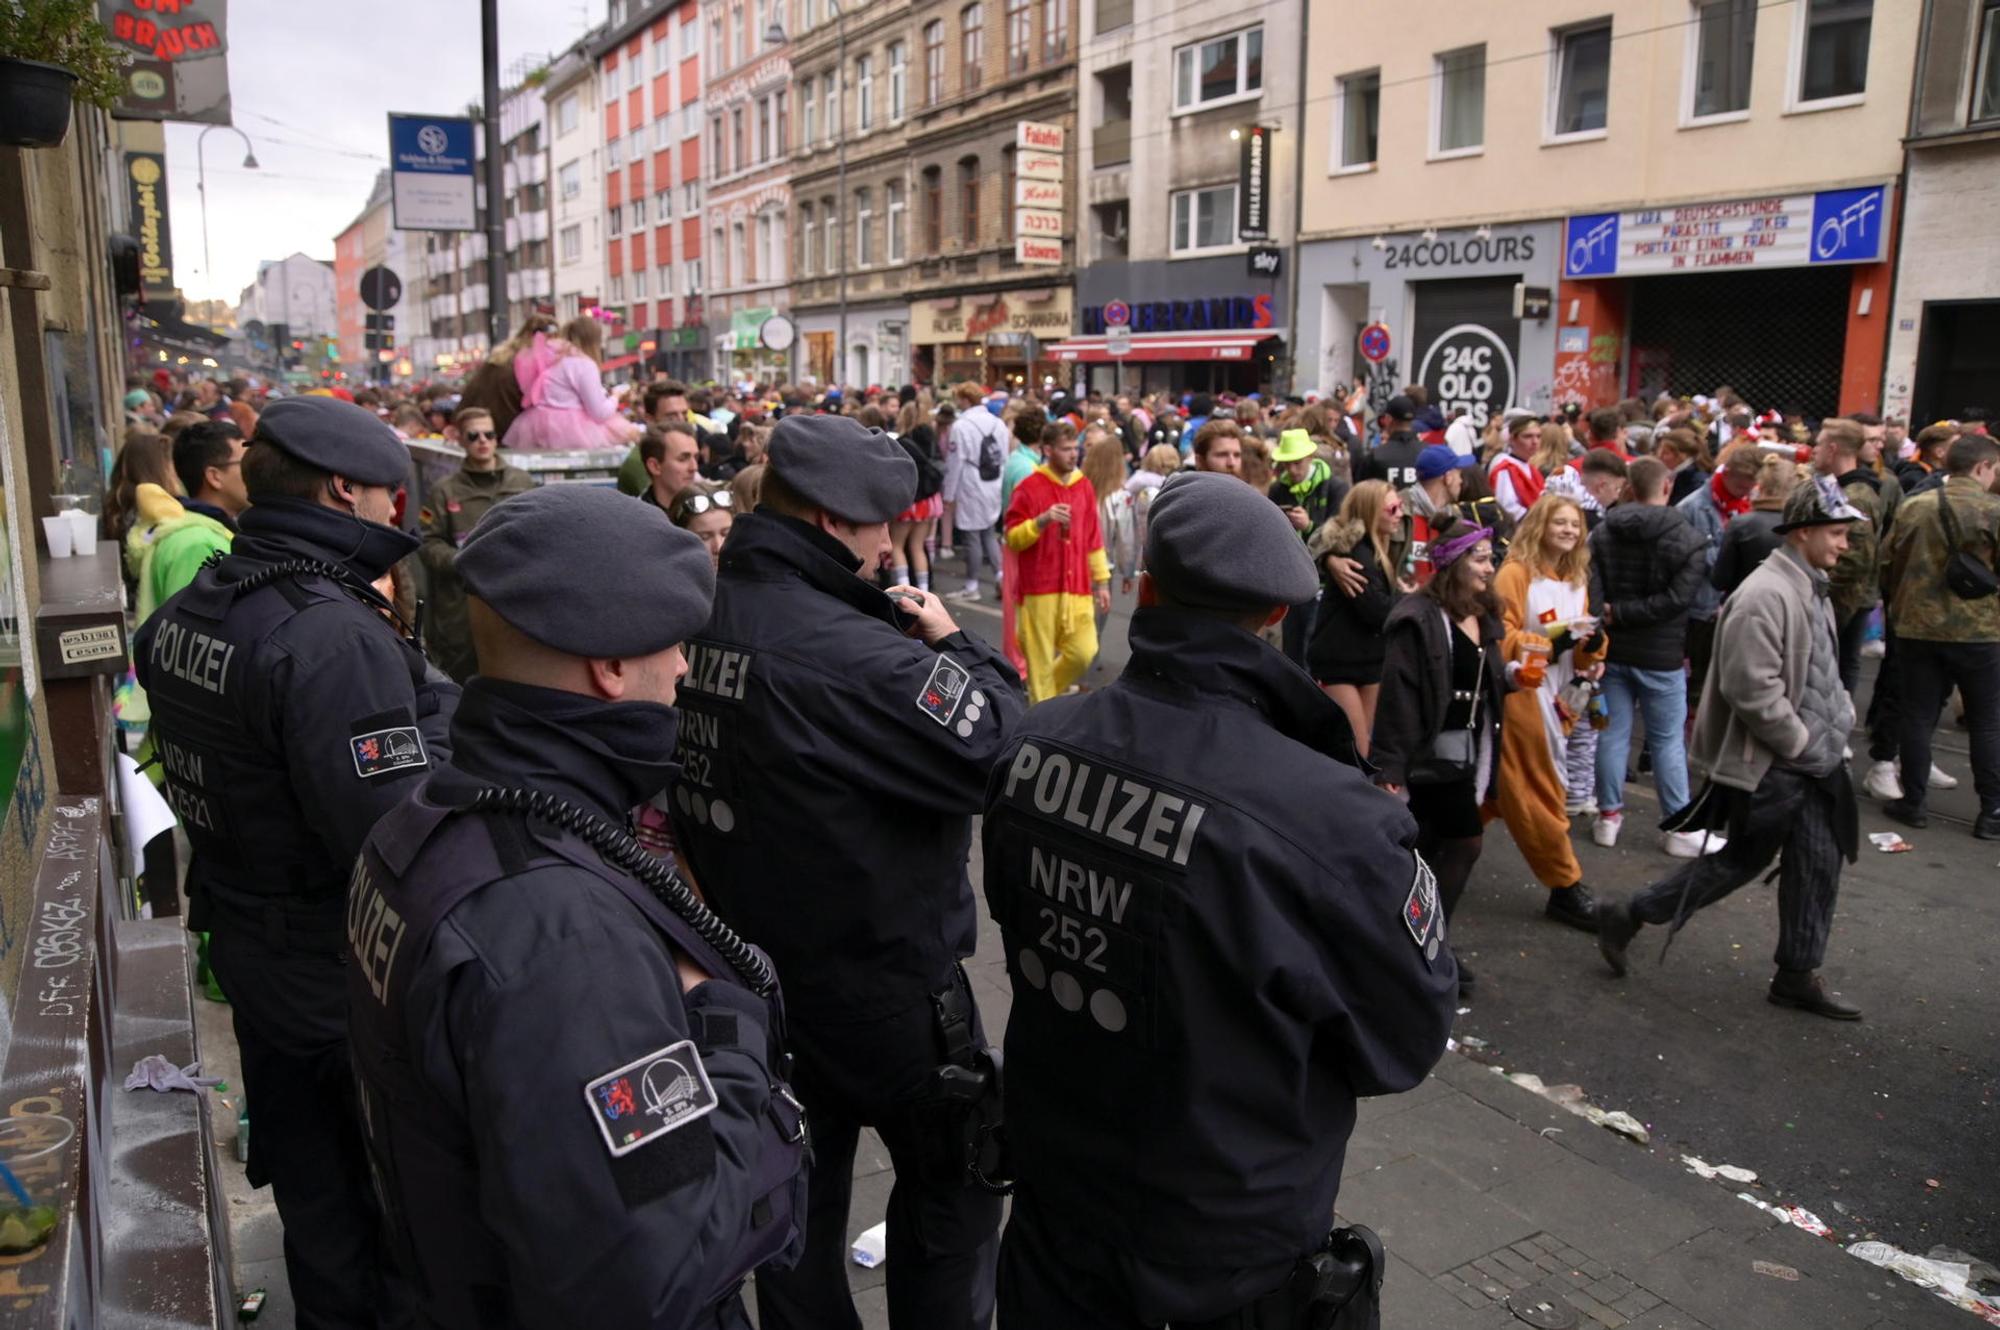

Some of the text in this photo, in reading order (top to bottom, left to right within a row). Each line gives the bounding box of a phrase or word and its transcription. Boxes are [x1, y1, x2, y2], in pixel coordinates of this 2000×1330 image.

[114, 11, 221, 62] BRAUCH
[1025, 125, 1060, 147] Falafel
[1662, 215, 1789, 238] PARASITE JOKER
[1673, 199, 1784, 223] DEUTSCHSTUNDE
[1816, 191, 1880, 259] OFF
[1254, 252, 1278, 272] sky
[1384, 235, 1535, 270] 24COLOURS
[1568, 216, 1615, 275] OFF
[1635, 232, 1776, 255] PORTRAIT EINER FRAU
[1671, 250, 1755, 268] IN FLAMMEN
[1082, 294, 1273, 335] HEBRANDS
[1441, 345, 1492, 373] 24C
[1438, 374, 1493, 400] OLO
[66, 645, 115, 659] Cesena
[151, 618, 235, 695] POLIZEI
[681, 640, 750, 700] LIZEI
[1005, 742, 1205, 866] POLIZEI
[1030, 847, 1133, 925] NRW
[347, 852, 407, 1007] POLIZEI
[1039, 907, 1108, 973] 252
